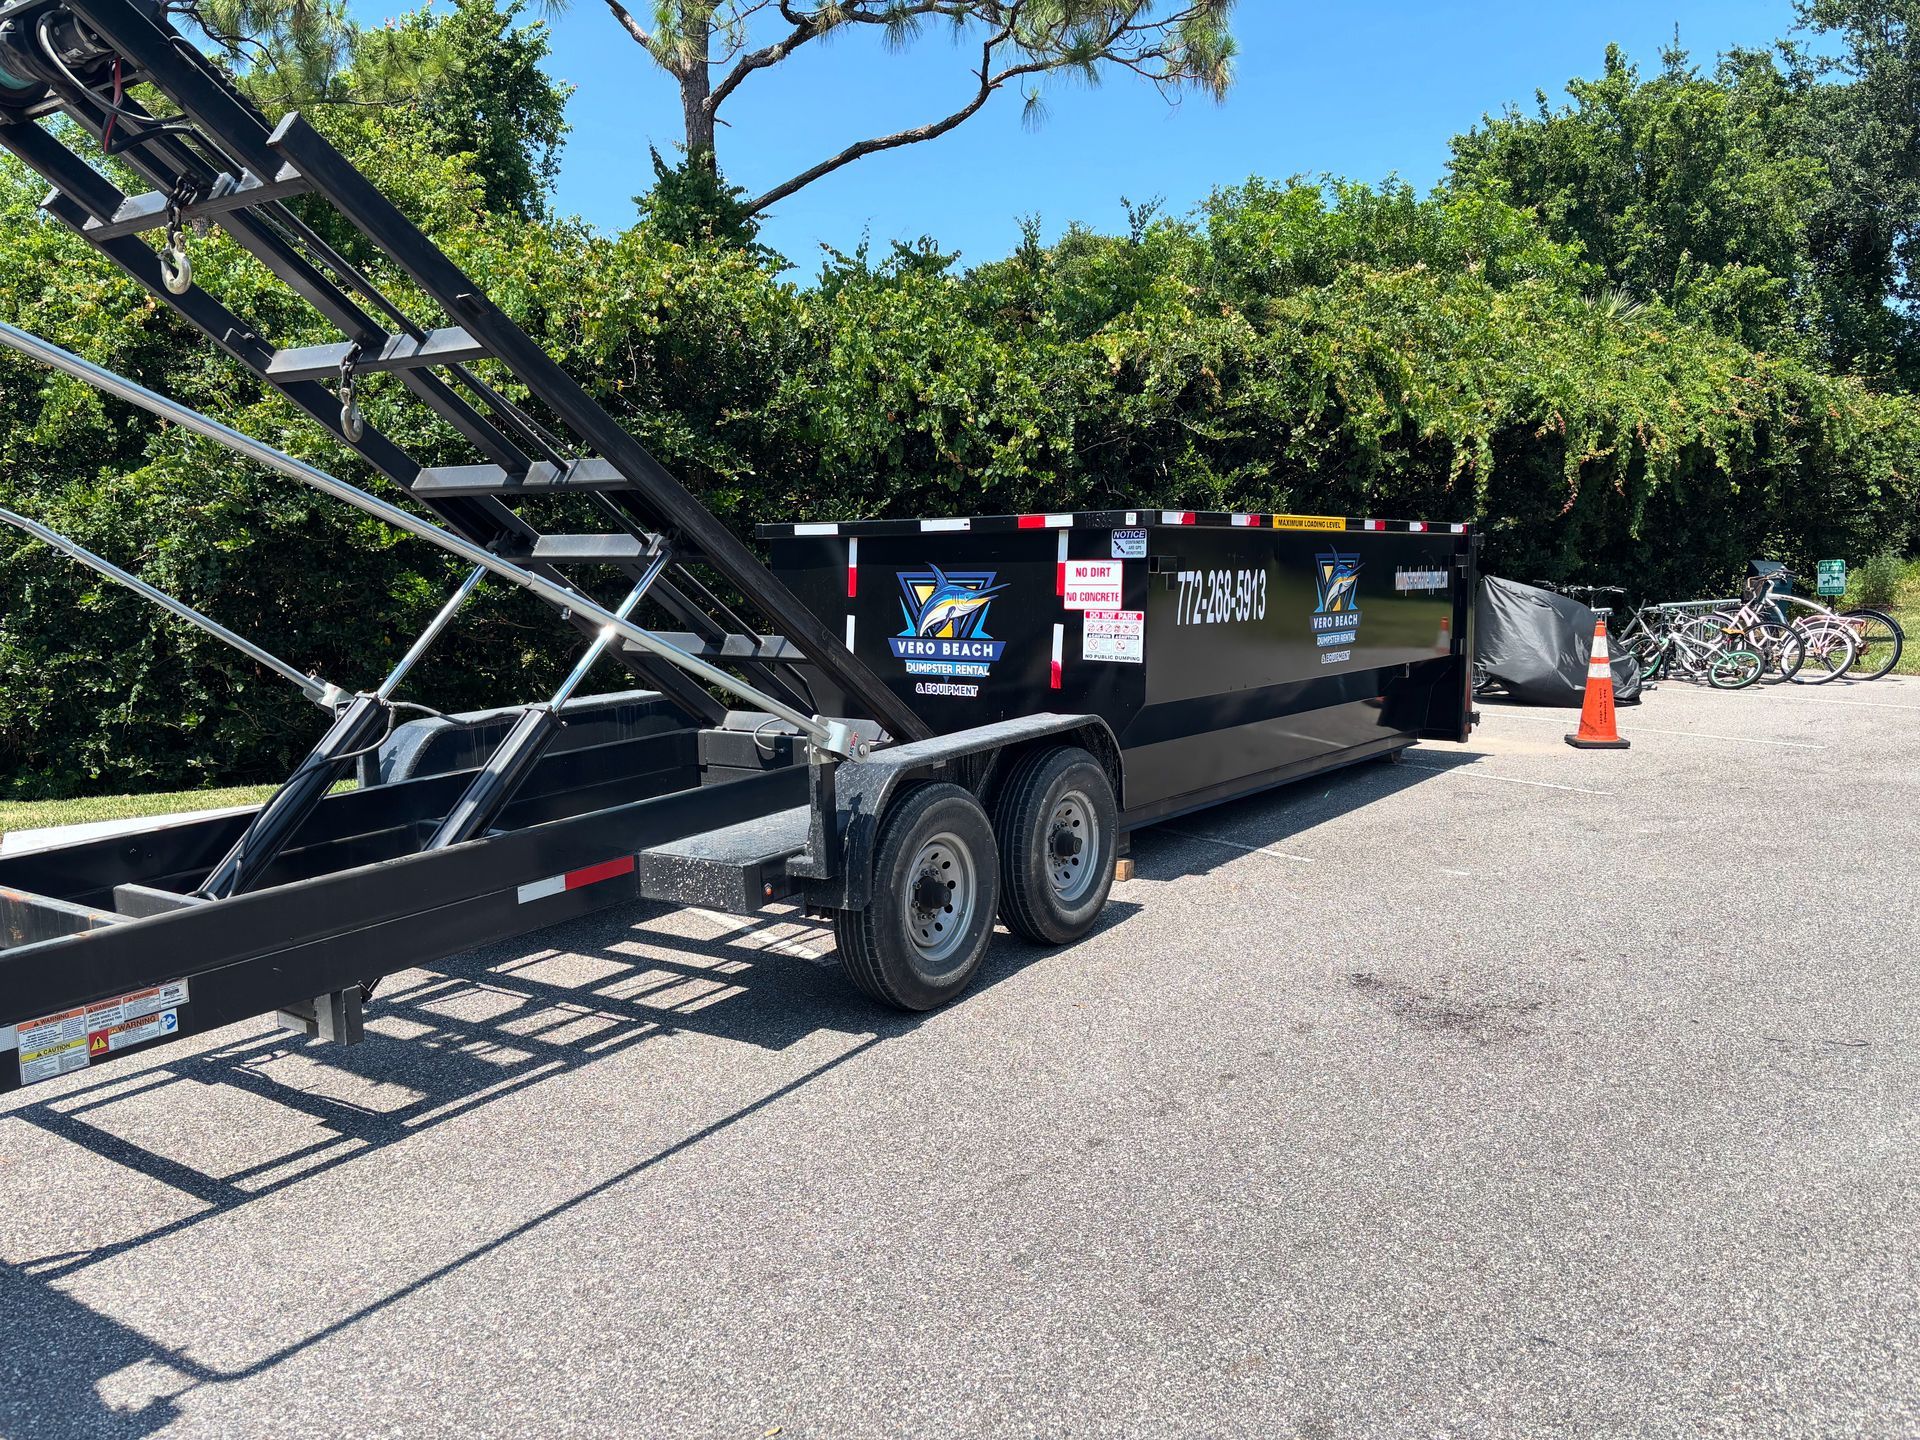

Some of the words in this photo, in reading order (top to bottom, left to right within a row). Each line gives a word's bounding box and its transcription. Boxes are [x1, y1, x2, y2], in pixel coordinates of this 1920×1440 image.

[1278, 519, 1303, 527] MAXIMUM
[1304, 520, 1325, 528] LOADING
[1326, 521, 1341, 529] LEVEL
[1113, 530, 1145, 539] NOTICE
[1075, 567, 1088, 578] NO
[1090, 567, 1111, 578] DIRT
[1066, 592, 1077, 602] NO
[1079, 592, 1120, 602] CONCRETE
[1176, 568, 1267, 626] 772-268-5913
[1090, 611, 1100, 619] DO
[1101, 611, 1115, 620] NOT
[1117, 612, 1137, 620] PARK
[1313, 616, 1333, 629] VERO
[1335, 614, 1358, 627] BEACH
[1316, 634, 1340, 646] DUMPSTER
[1340, 632, 1356, 642] RENTAL
[897, 641, 936, 655] VERO
[942, 642, 993, 657] BEACH
[905, 662, 953, 674] DUMPSTER
[955, 664, 990, 676] RENTAL
[915, 682, 925, 693] &
[925, 683, 979, 697] EQUIPMENT
[93, 999, 120, 1012] WARNING
[40, 1012, 70, 1025] WARNING
[117, 1015, 156, 1032] WARNING
[43, 1043, 71, 1056] CAUTION
